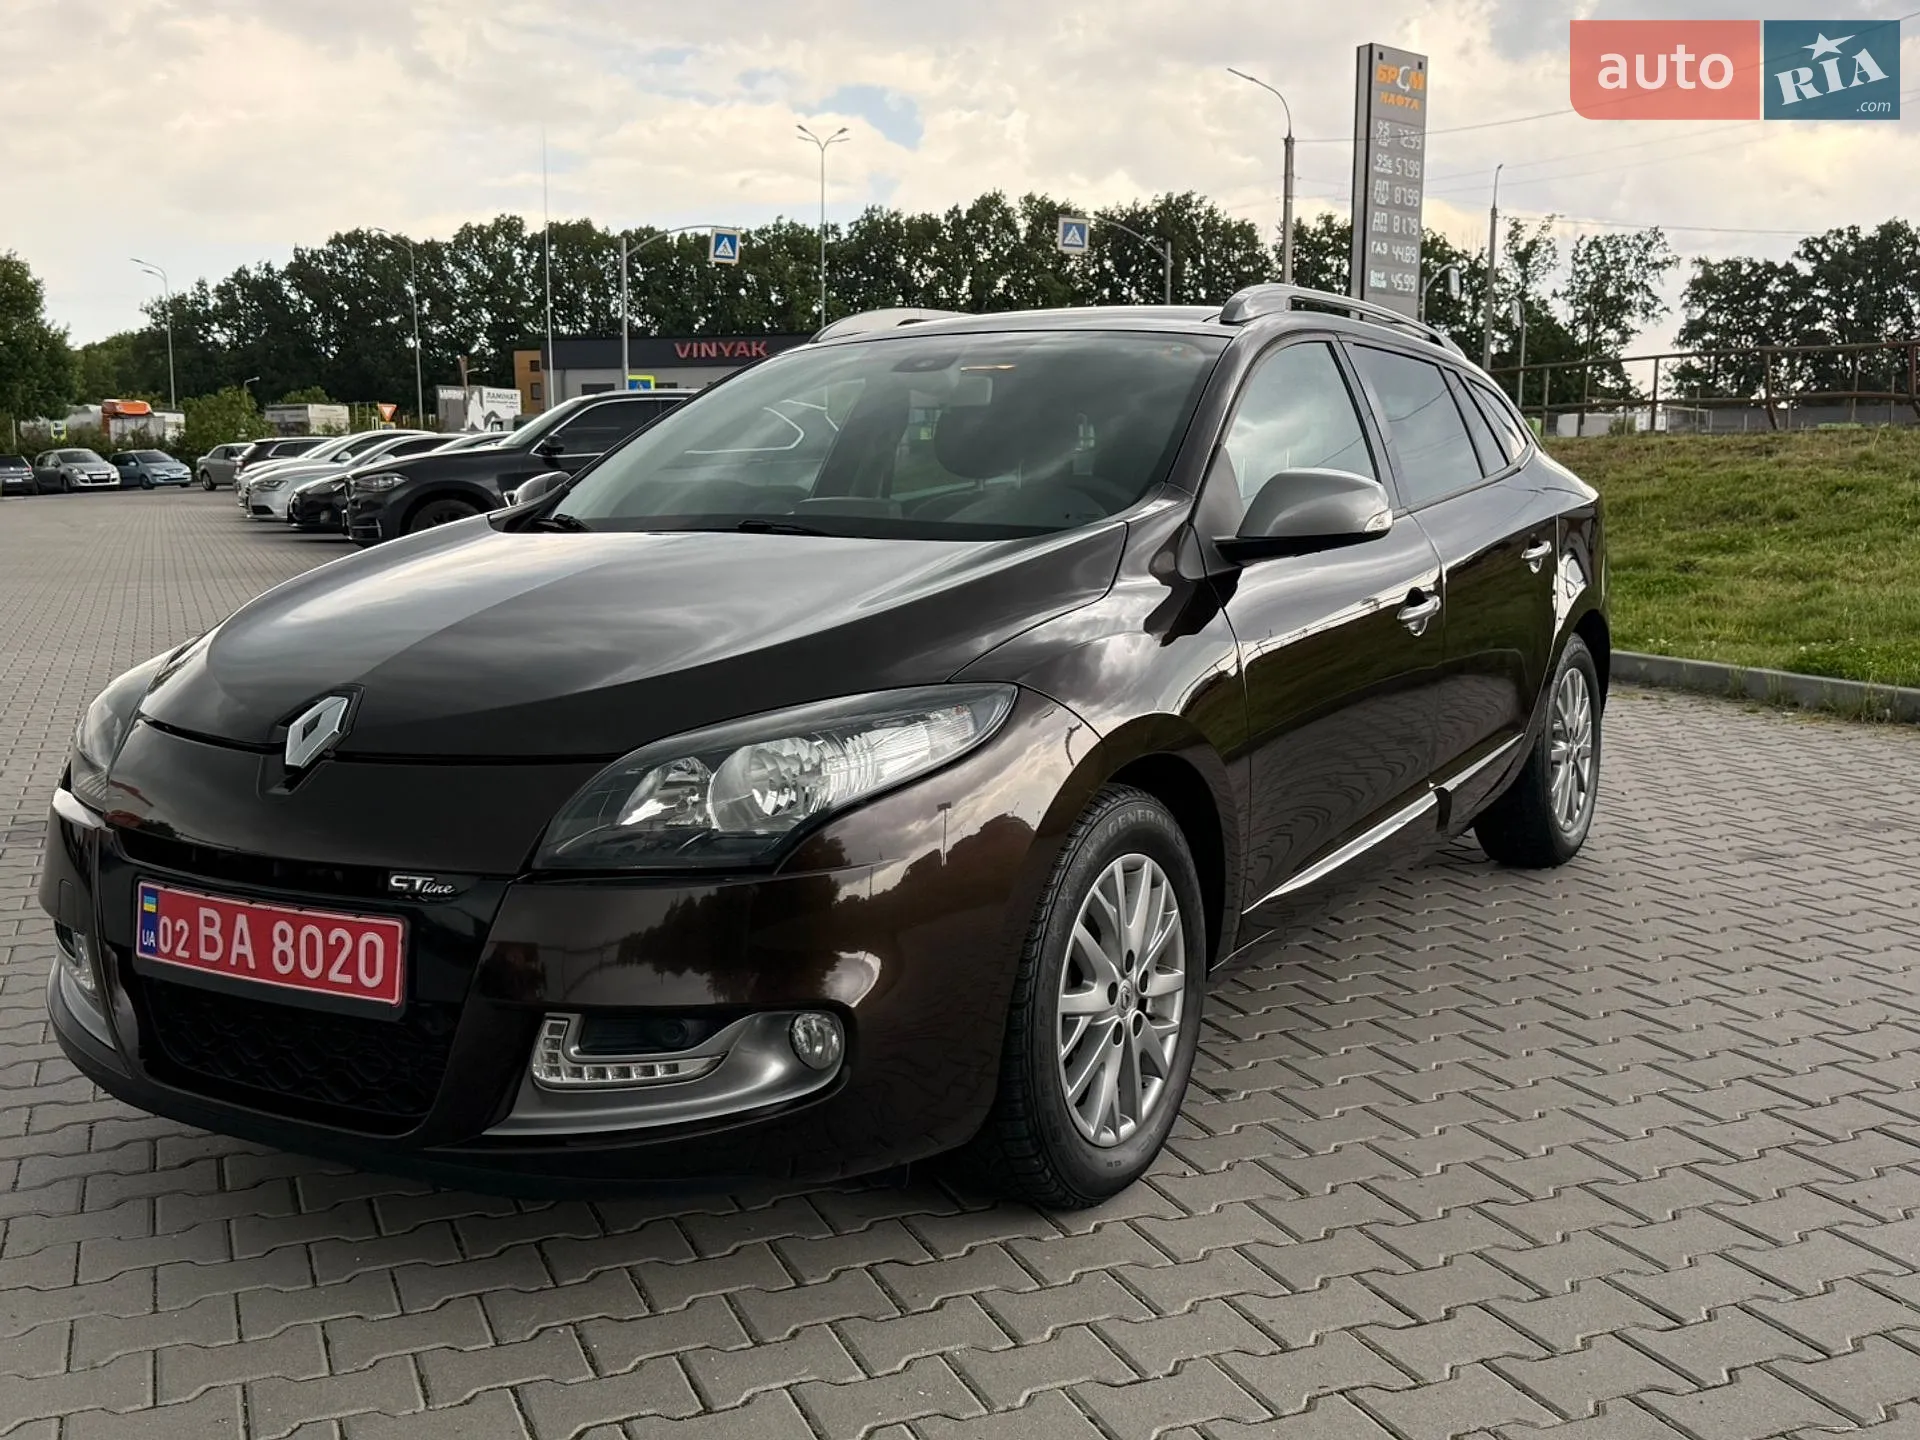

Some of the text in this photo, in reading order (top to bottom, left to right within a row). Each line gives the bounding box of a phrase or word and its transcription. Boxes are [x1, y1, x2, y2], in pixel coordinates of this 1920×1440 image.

[1371, 241, 1388, 255] ГАЗ
[674, 341, 767, 358] VINYAK
[142, 929, 156, 948] UA
[158, 906, 385, 988] 02 BA 8020
